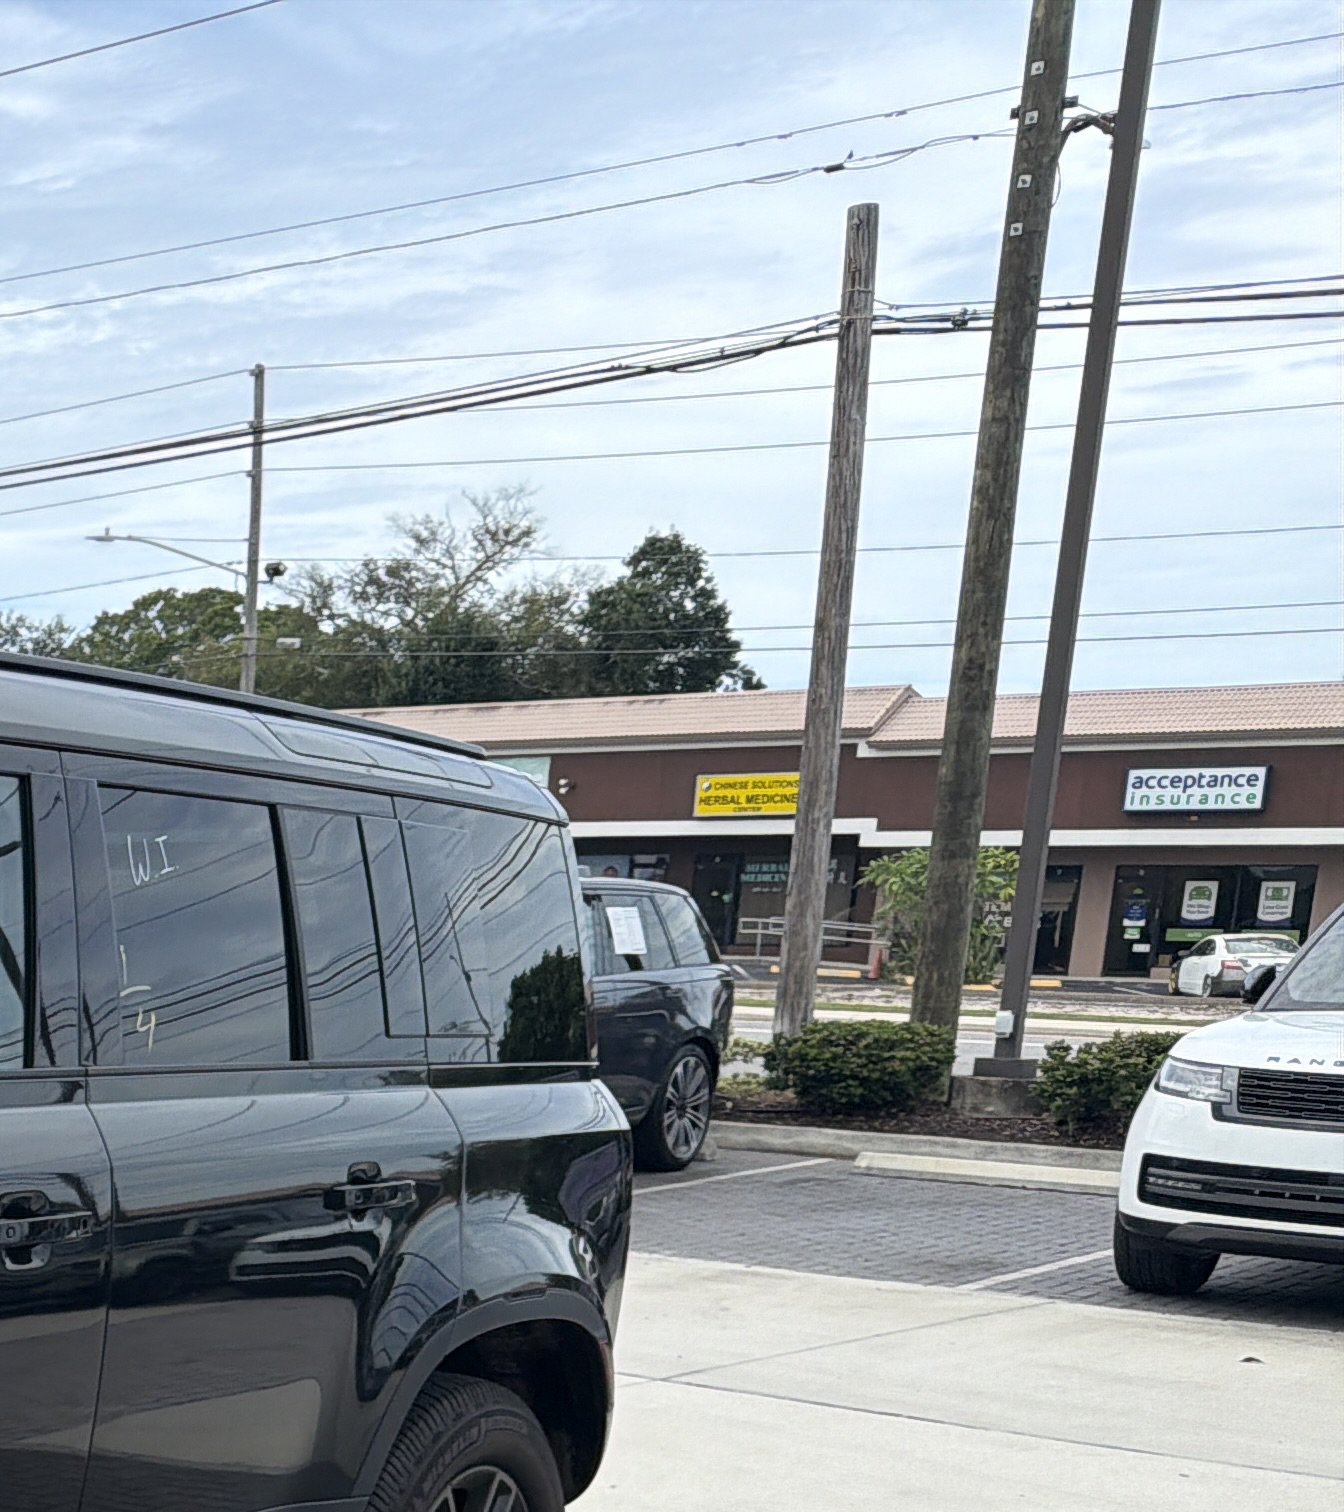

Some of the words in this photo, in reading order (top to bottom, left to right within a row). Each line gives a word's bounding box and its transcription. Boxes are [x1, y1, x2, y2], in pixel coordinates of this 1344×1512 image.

[1131, 771, 1260, 793] acceptance
[698, 794, 743, 806] HERBAL
[745, 792, 799, 805] MEDICINE
[1129, 791, 1258, 806] insurance
